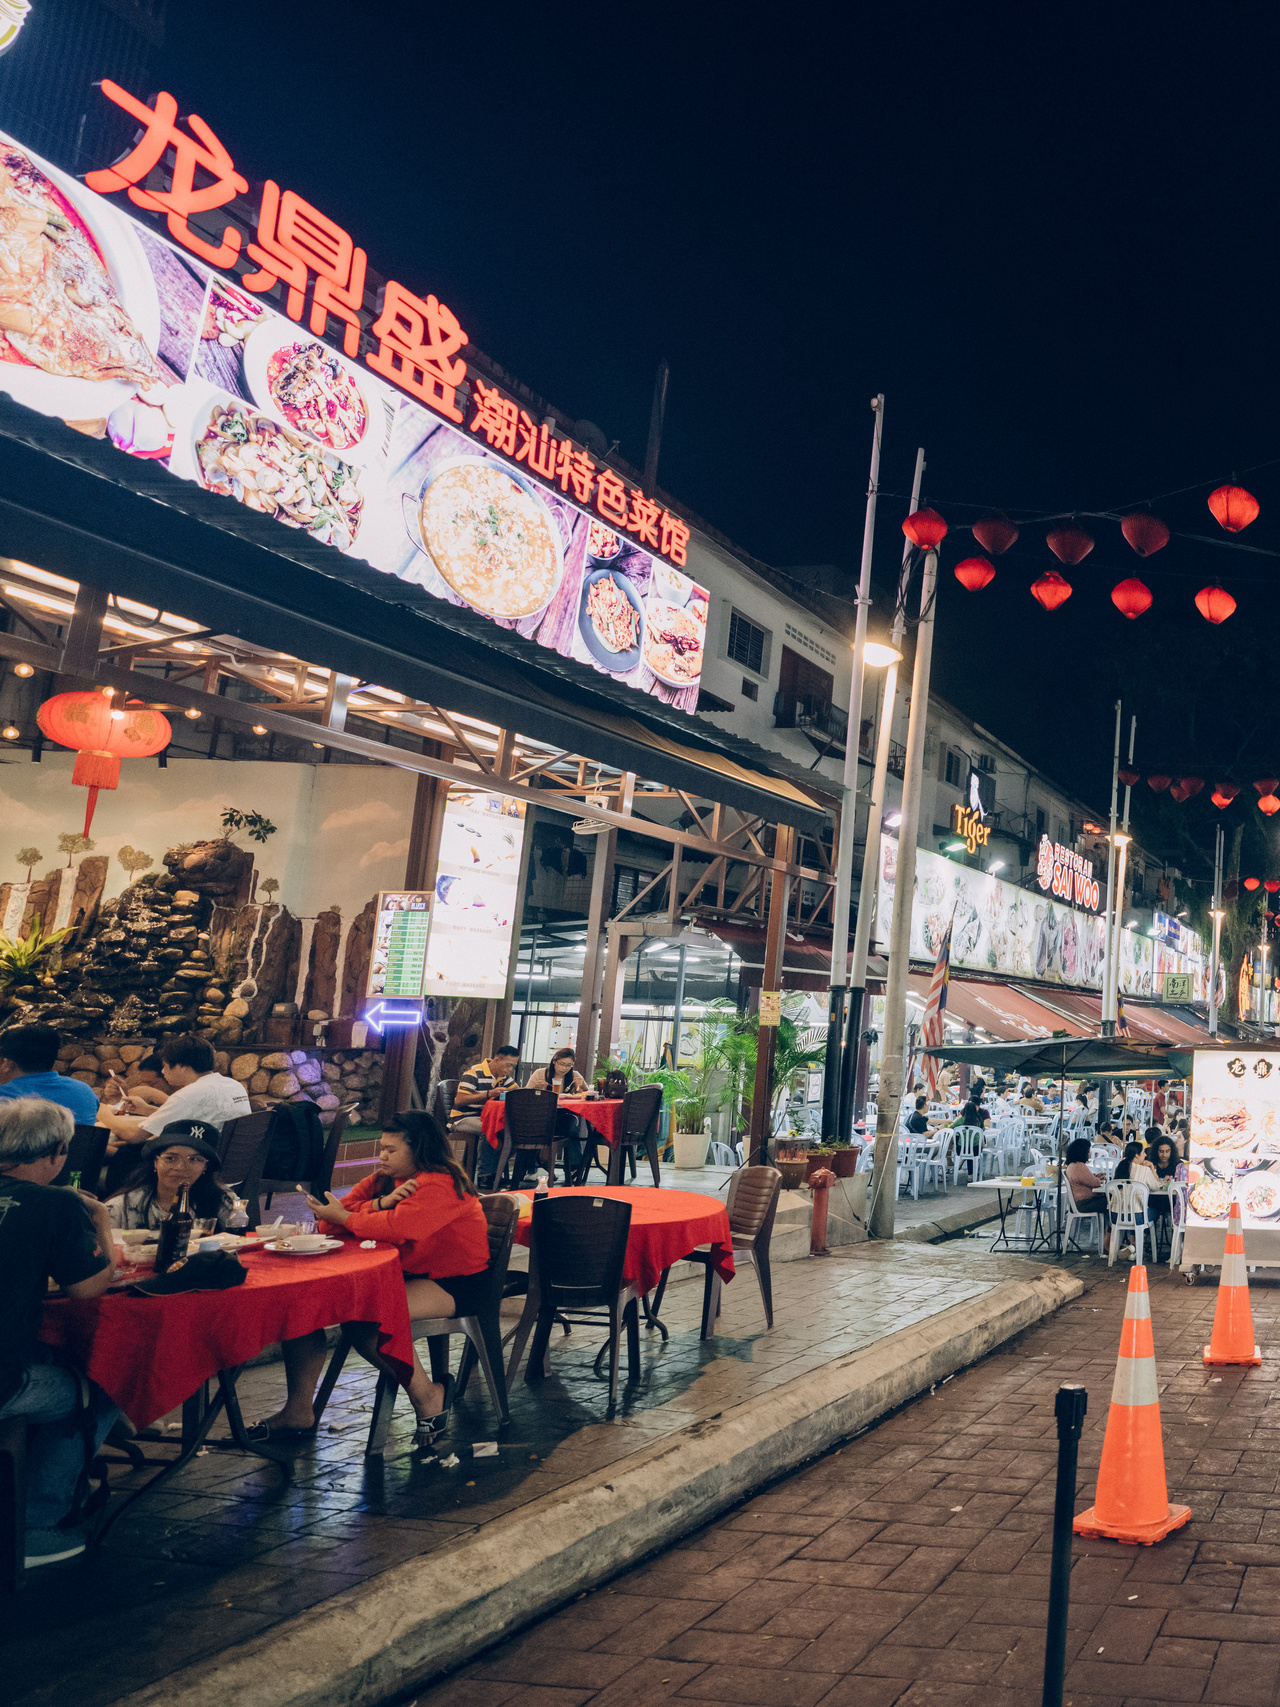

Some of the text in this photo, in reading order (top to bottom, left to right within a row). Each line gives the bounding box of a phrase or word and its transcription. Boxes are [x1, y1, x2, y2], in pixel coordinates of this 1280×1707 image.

[85, 78, 691, 568] 龙鼎盛 潮汕特色菜馆
[955, 803, 991, 855] Tiger
[1054, 842, 1093, 879] RESTORAN
[1051, 862, 1100, 911] SAI WOO
